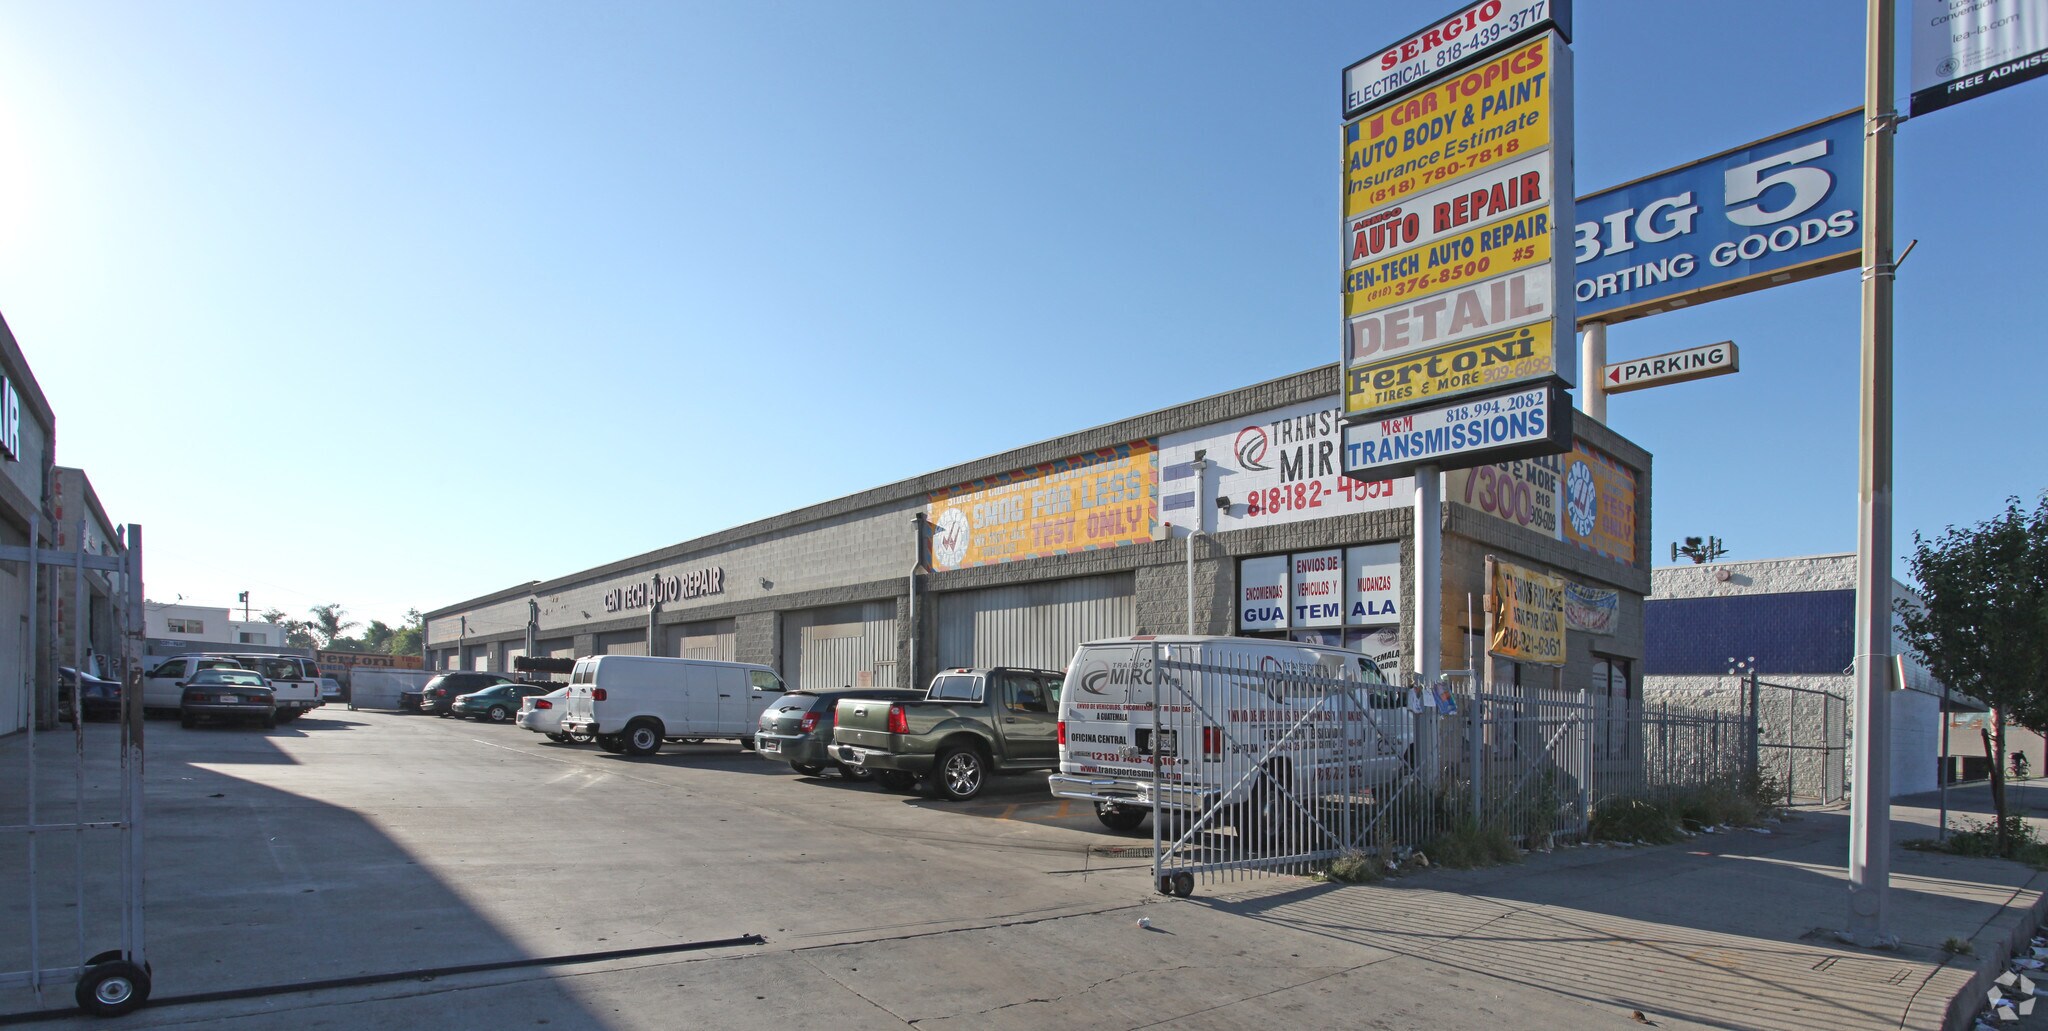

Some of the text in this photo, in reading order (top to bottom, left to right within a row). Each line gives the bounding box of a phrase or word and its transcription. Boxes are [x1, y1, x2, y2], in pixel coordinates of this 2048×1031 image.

[1381, 0, 1502, 71] SERGIO
[1953, 13, 2020, 43] lea-la.com
[1348, 1, 1545, 109] ELECTRICAL 818-439-3717
[1391, 44, 1544, 127] CAR TOPICS
[1947, 74, 1985, 94] FREE
[1988, 52, 2048, 81] ADMISS
[1349, 72, 1546, 173] AUTO BODY & PAINT
[1348, 110, 1539, 195] Insurance Estimate
[1369, 138, 1520, 205] (818) 780-7818
[1353, 170, 1541, 260] AUTO REPAIR
[1575, 139, 1833, 264] BIG 5
[1352, 207, 1402, 232] ARMCO
[1347, 213, 1548, 294] CEN-TECH AUTO REPAIR
[1575, 209, 1855, 302] ORTING GOODS
[1367, 245, 1536, 302] (818) 376-8500 #5
[1350, 275, 1544, 360] DETAIL
[1483, 355, 1551, 383] 909-6099
[1625, 348, 1724, 380] PARKING
[1375, 386, 1413, 404] TIRES
[1421, 381, 1430, 394] &
[1437, 371, 1479, 392] MORE
[1446, 391, 1544, 424] 818.994.2082
[1348, 408, 1545, 467] TRANSMISSIONS
[1381, 416, 1413, 437] M&M
[1280, 441, 1334, 483] MIR
[1526, 463, 1556, 493] MORE
[1567, 461, 1596, 502] SMOG
[973, 470, 1140, 529] SMOG FOR LESS
[1535, 491, 1551, 508] 818
[1602, 493, 1632, 522] TEST
[1032, 504, 1142, 547] TEST ONLY
[1567, 501, 1596, 537] CHECK
[1602, 513, 1632, 542] ONLY
[1296, 556, 1338, 574] ENVIOS DE
[604, 566, 722, 611] CEN TECH AUTO REPAIR
[1246, 585, 1283, 601] ENCOMIENDAS
[1297, 580, 1338, 597] VEHICULOS Y
[1357, 575, 1391, 593] MUDANZAS
[1244, 599, 1397, 622] GUA TEM ALA
[1379, 661, 1398, 670] ADOR
[1096, 712, 1128, 721] A GUATEMALA
[1071, 733, 1127, 744] OFICINA CENTRAL
[1080, 766, 1182, 780] www.transportesmirn.com
[1091, 752, 1119, 762] (213)
